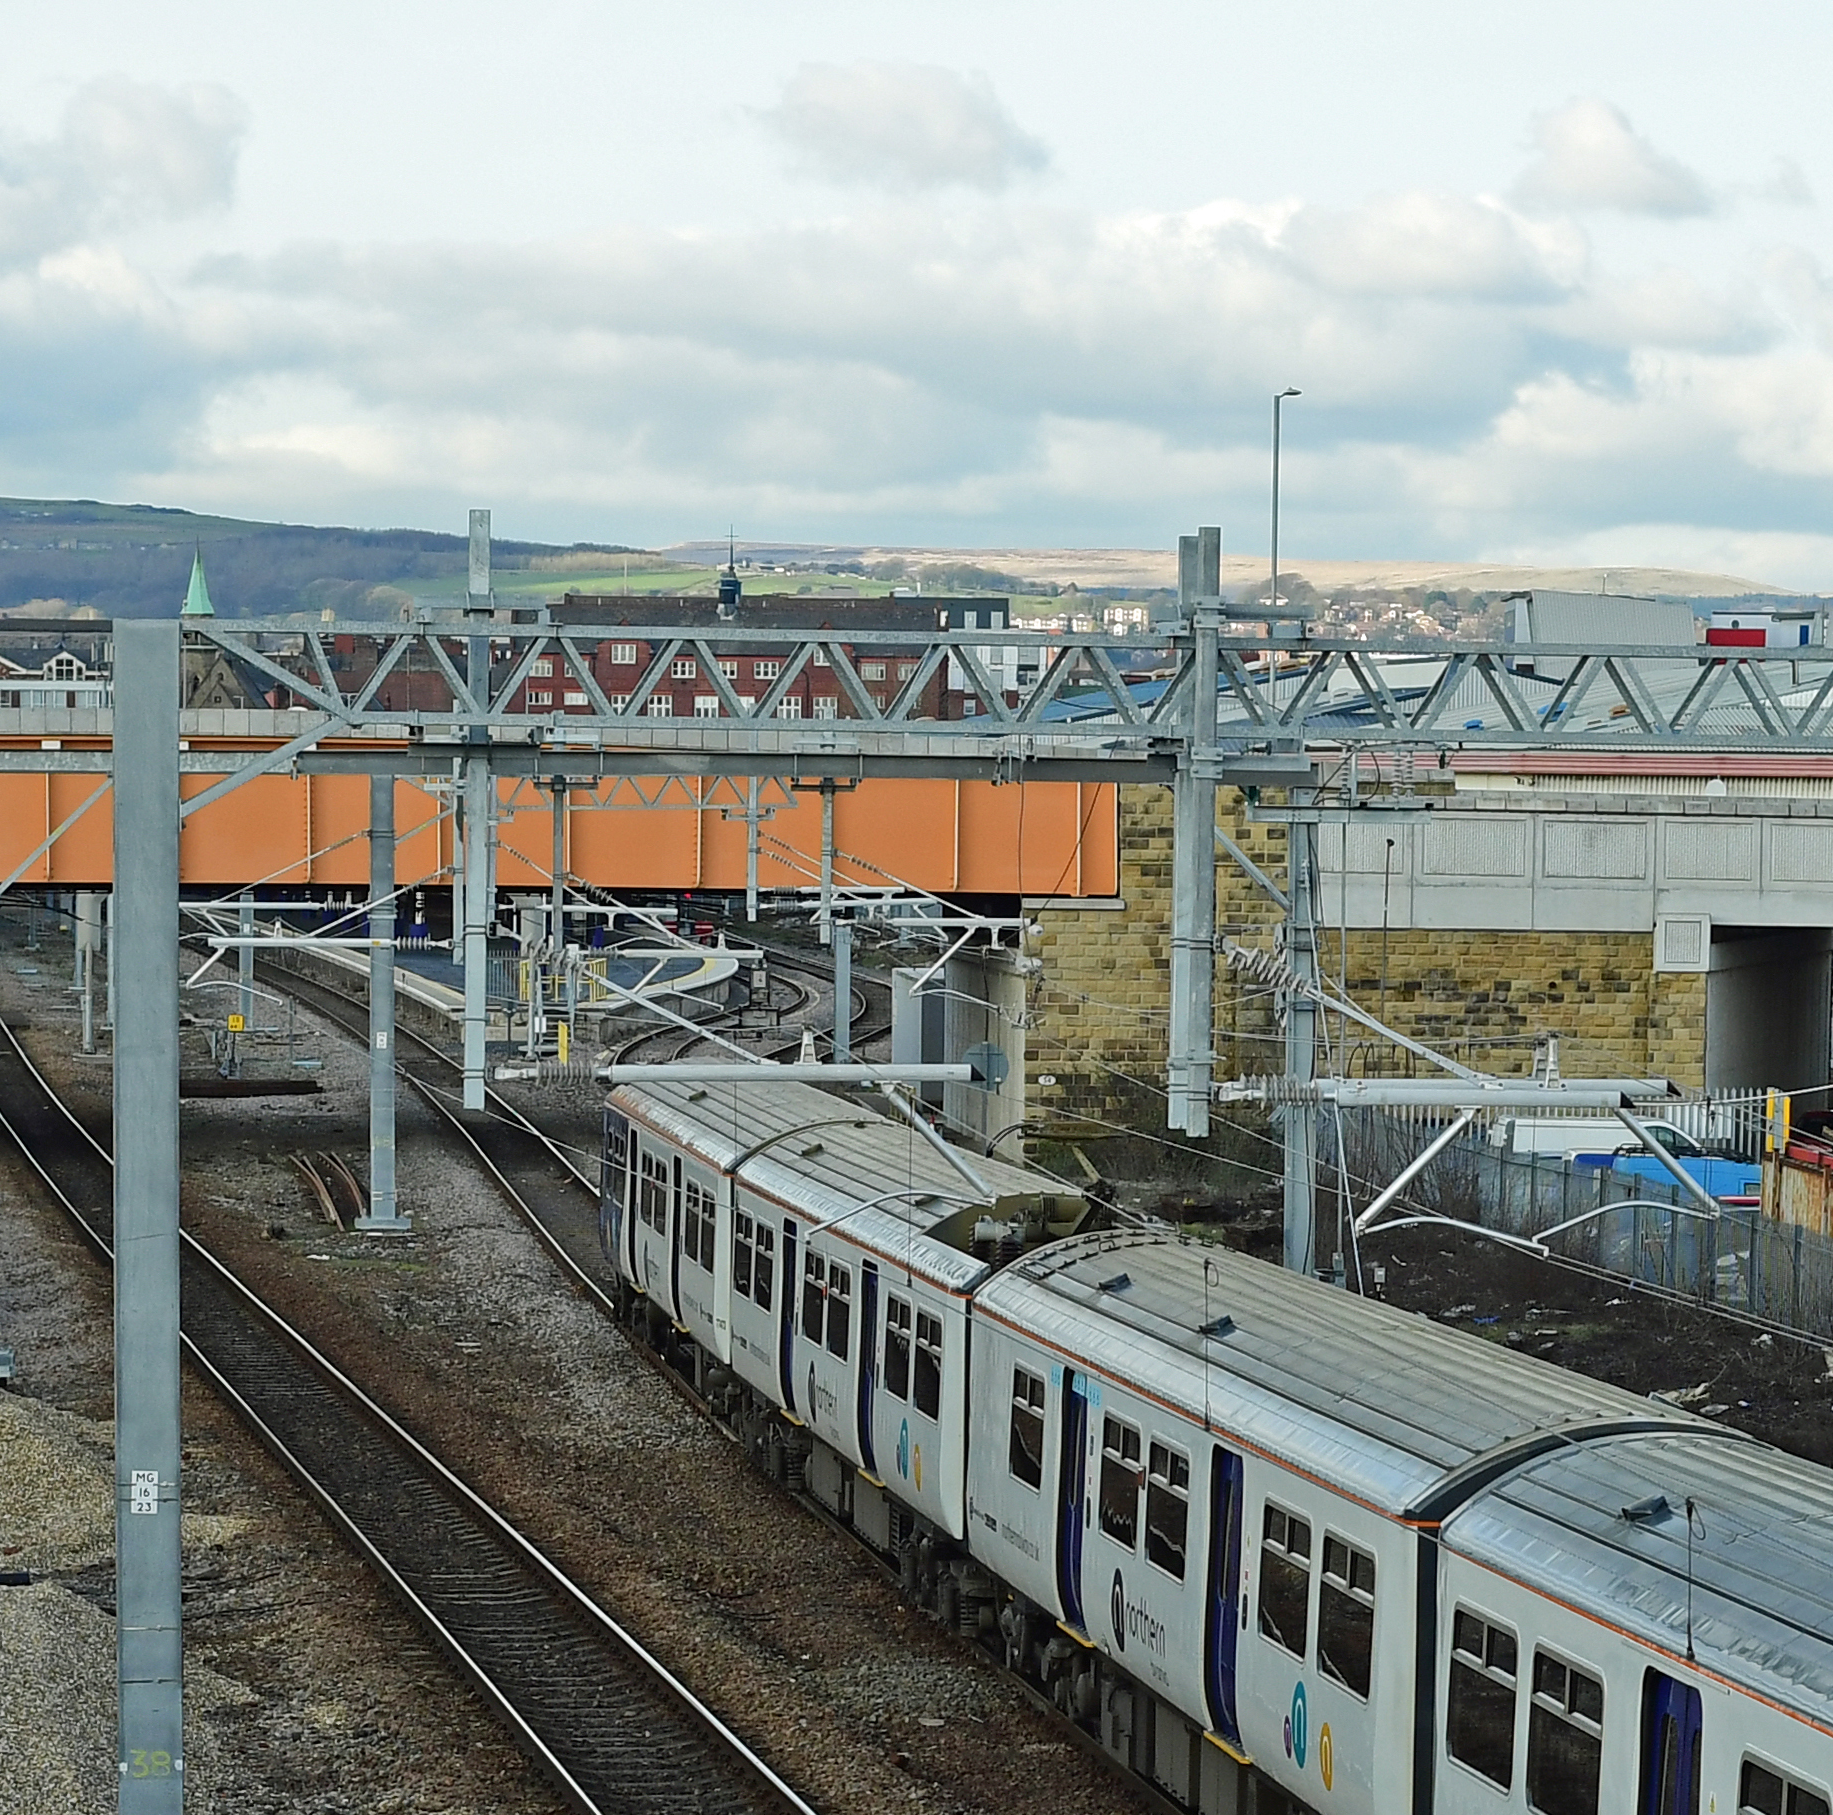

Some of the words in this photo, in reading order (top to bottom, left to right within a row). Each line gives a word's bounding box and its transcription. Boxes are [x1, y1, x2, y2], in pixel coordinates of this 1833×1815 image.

[136, 1472, 155, 1483] MG
[139, 1487, 150, 1497] 16
[136, 1502, 152, 1512] 23
[1125, 1596, 1166, 1659] northern
[130, 1749, 171, 1778] 38
